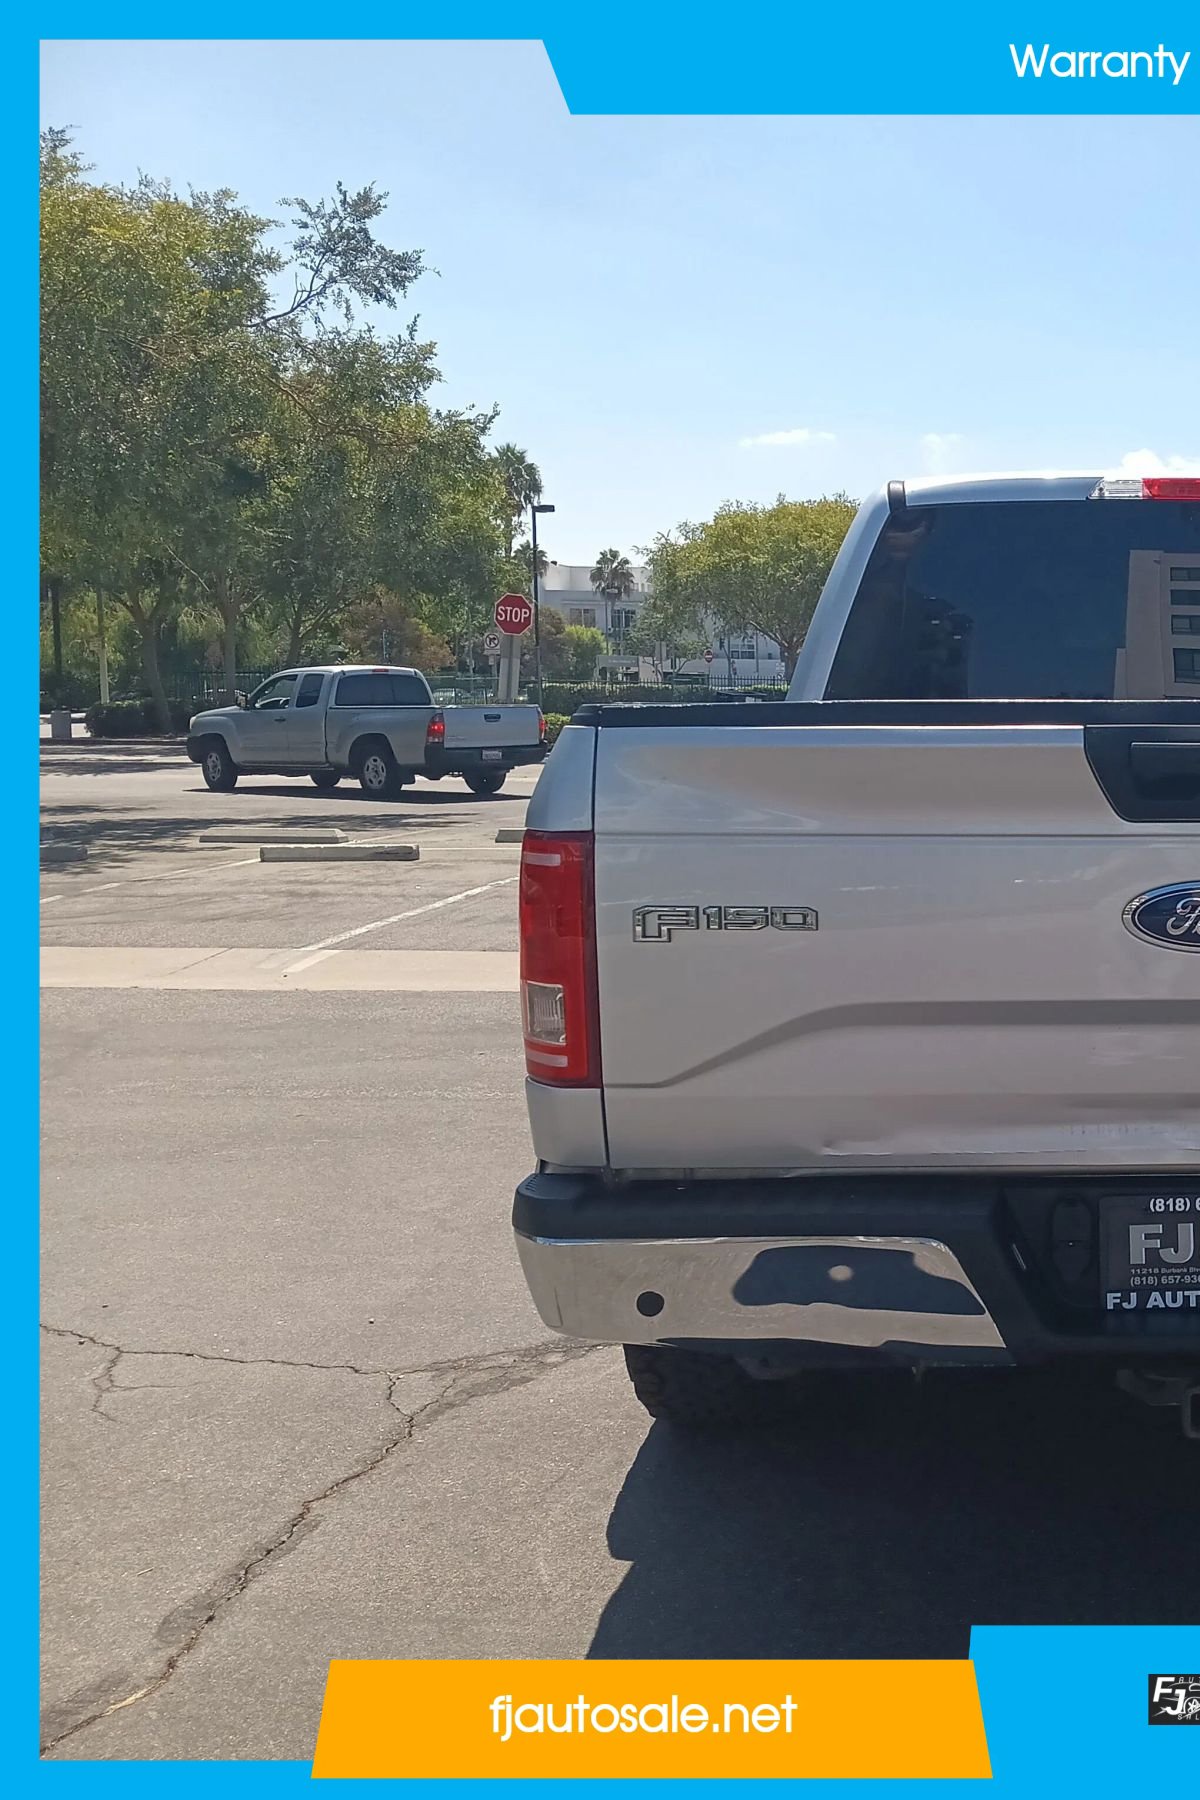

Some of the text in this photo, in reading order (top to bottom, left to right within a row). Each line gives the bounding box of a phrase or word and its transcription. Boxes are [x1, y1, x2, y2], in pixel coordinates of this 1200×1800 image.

[497, 606, 530, 623] STOP
[1149, 1198, 1191, 1212] (818)
[1129, 1222, 1194, 1265] FJ
[1161, 1266, 1188, 1274] Burbank
[1130, 1276, 1158, 1287] (818)
[1106, 1292, 1137, 1310] FJ
